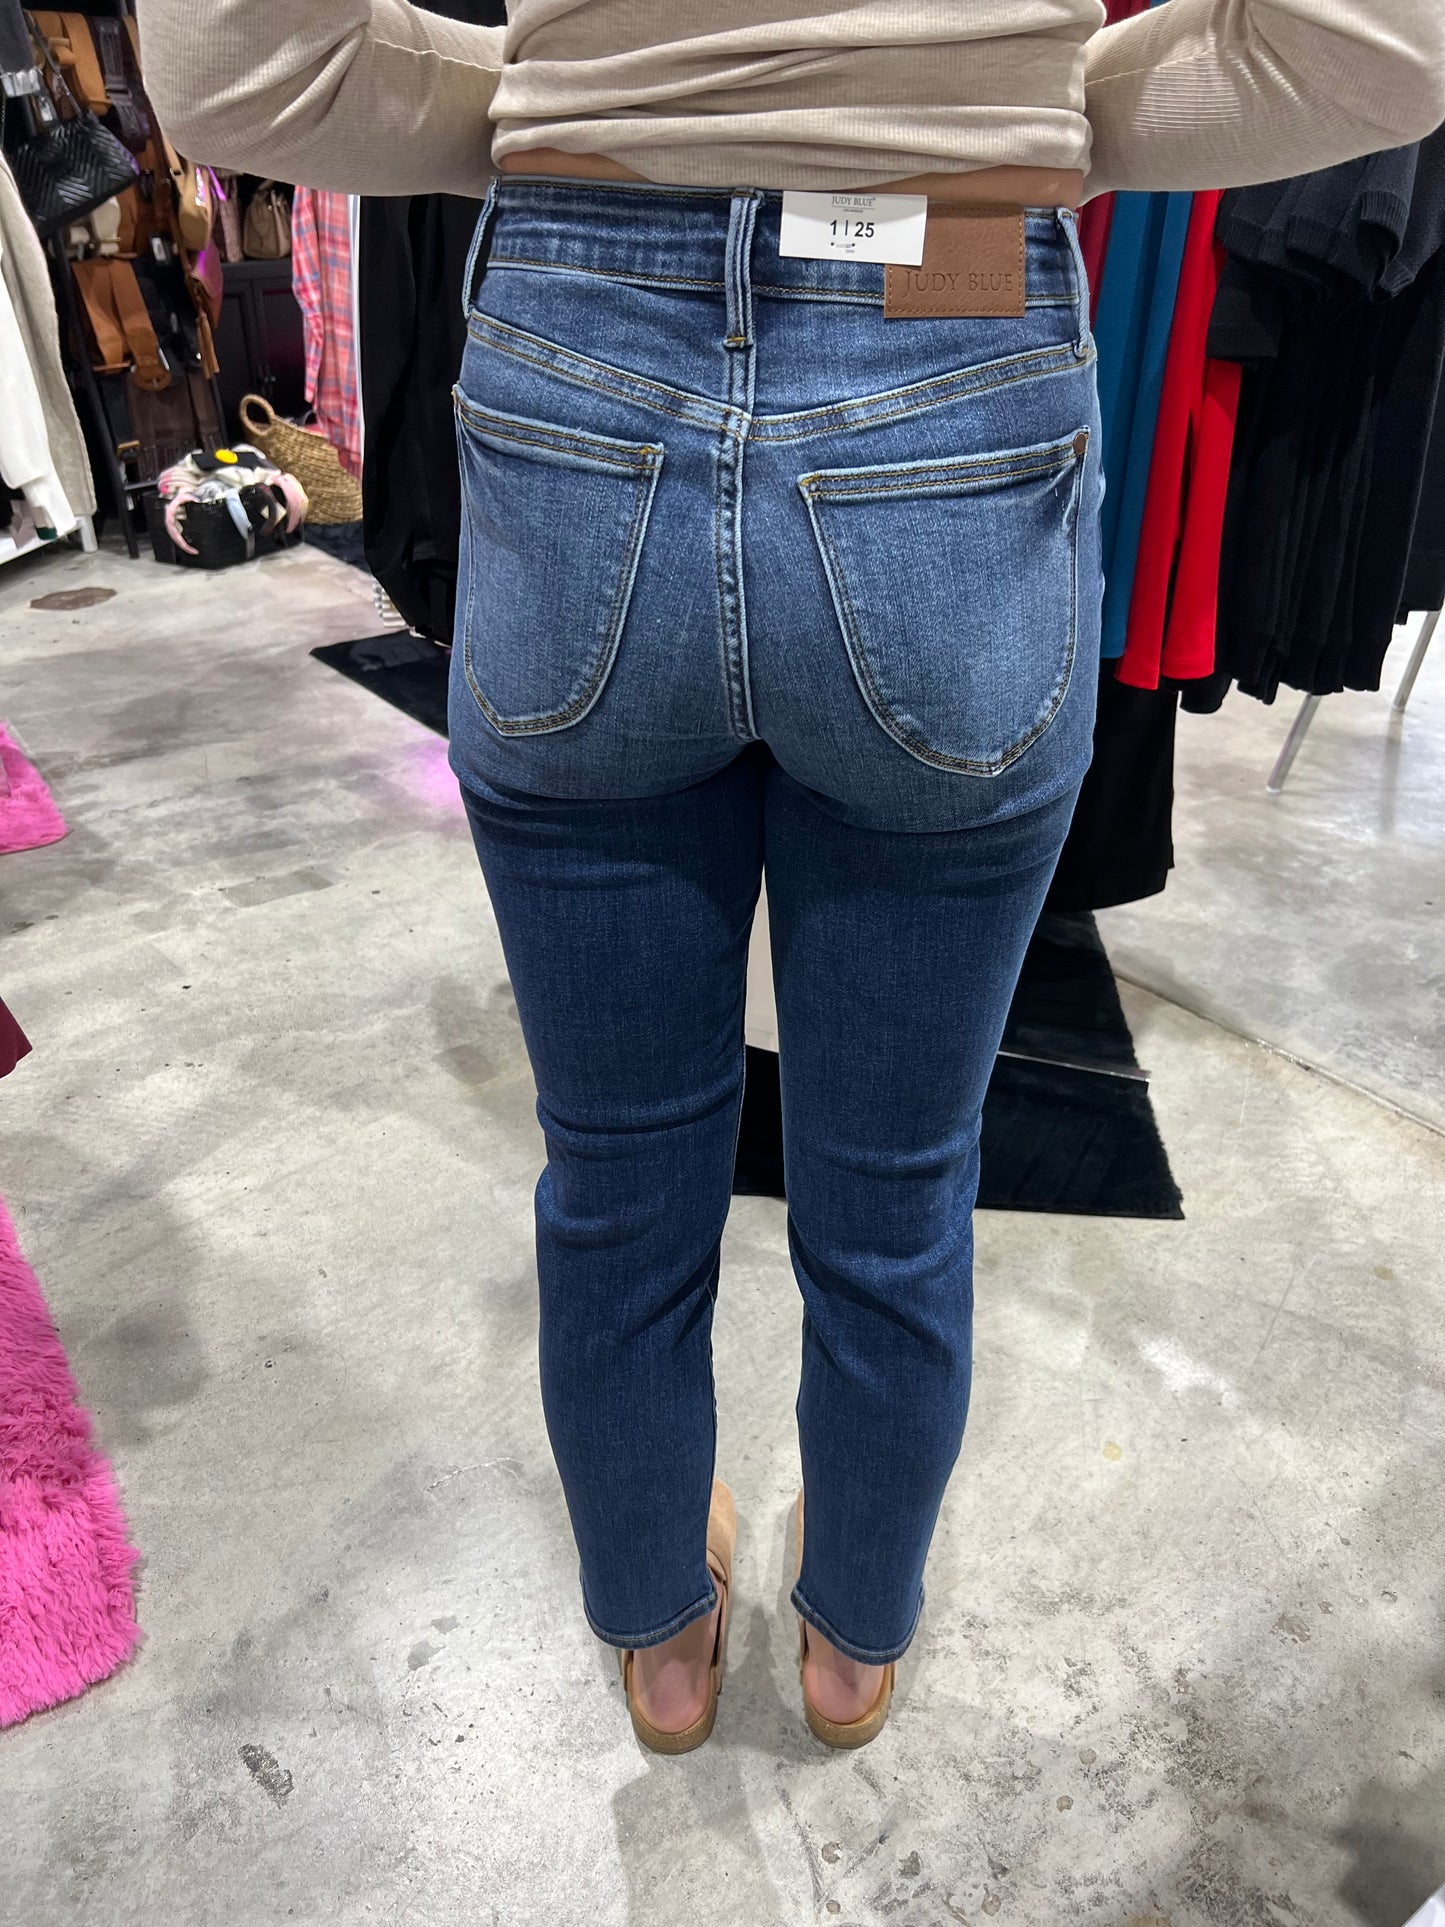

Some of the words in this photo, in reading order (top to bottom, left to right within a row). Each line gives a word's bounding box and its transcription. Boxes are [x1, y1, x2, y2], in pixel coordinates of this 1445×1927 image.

[832, 195, 853, 206] JUDY
[854, 221, 875, 238] 25
[903, 270, 960, 297] JUDY
[969, 272, 1013, 292] BLUE
